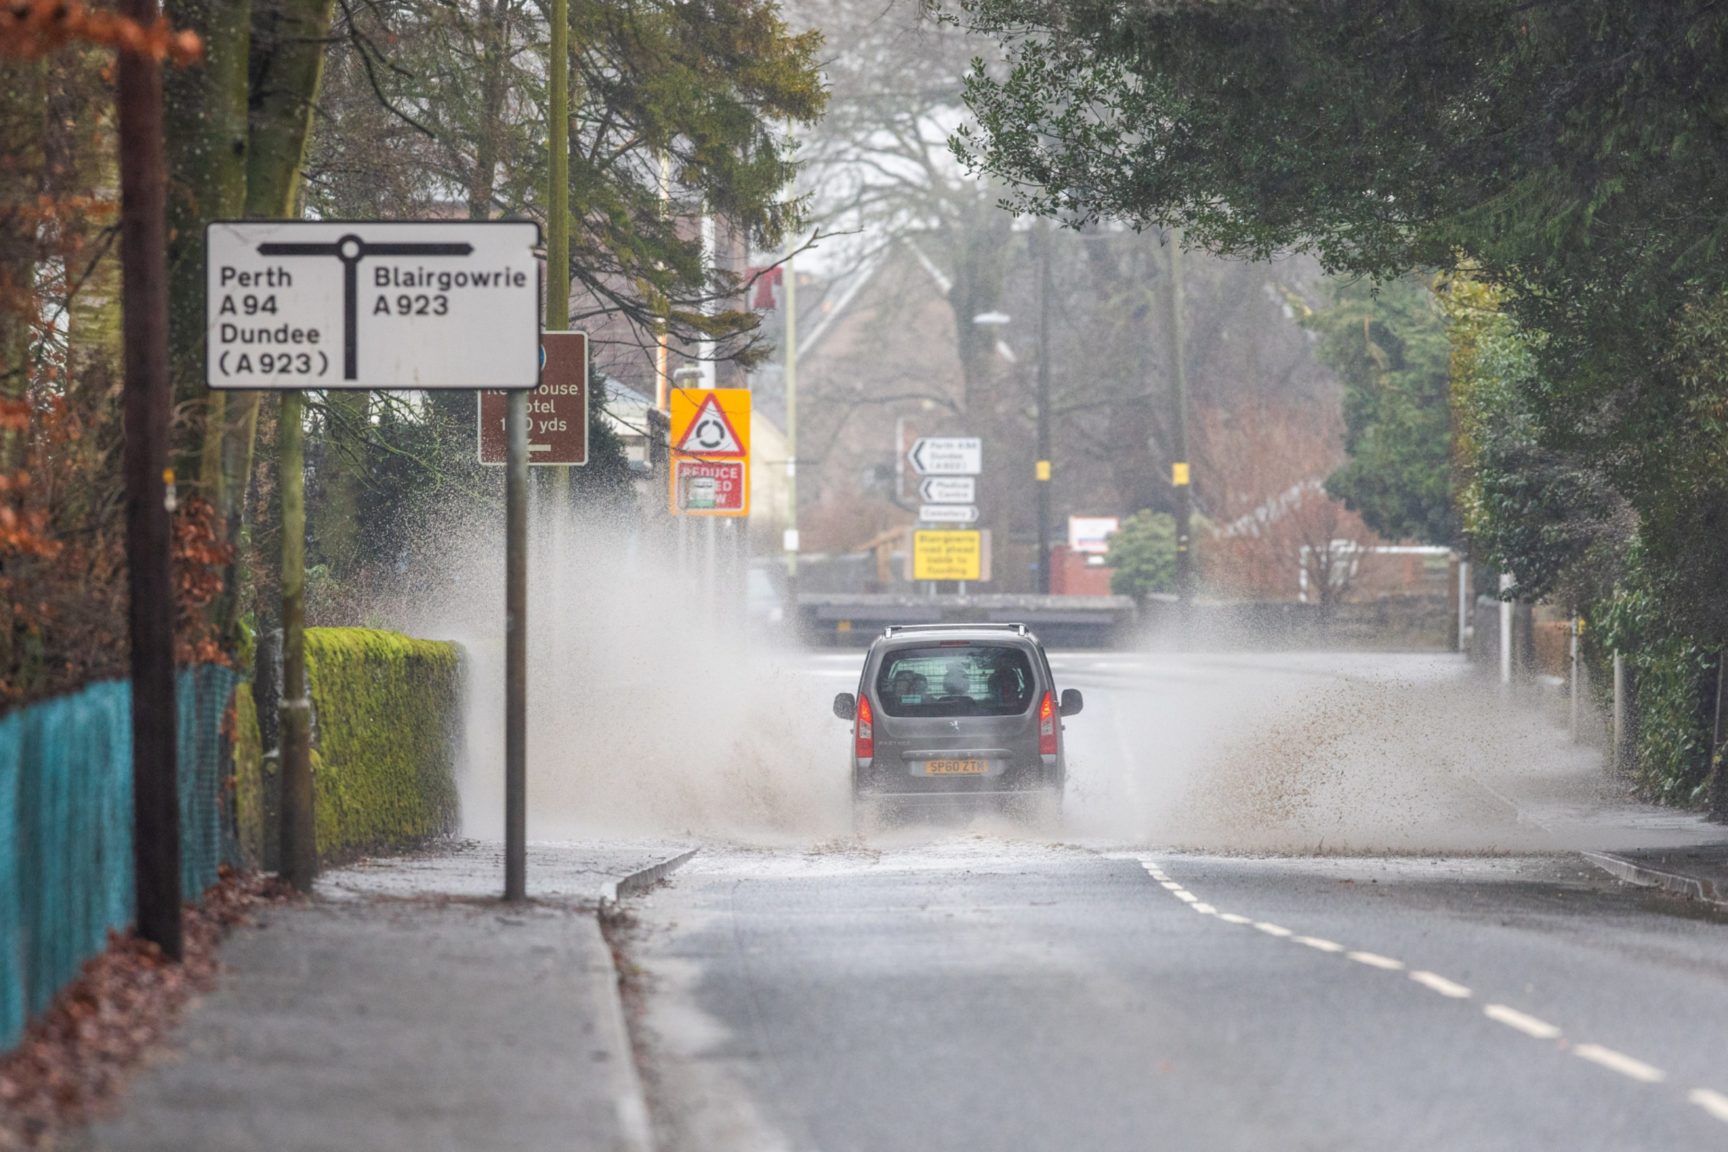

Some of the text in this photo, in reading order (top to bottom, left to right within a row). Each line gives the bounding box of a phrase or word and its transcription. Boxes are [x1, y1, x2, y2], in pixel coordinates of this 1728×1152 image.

[220, 266, 292, 287] Perth
[374, 266, 527, 291] Blairgowrie
[220, 323, 320, 344] Dundee
[540, 418, 567, 434] yds
[929, 760, 960, 772] SP60
